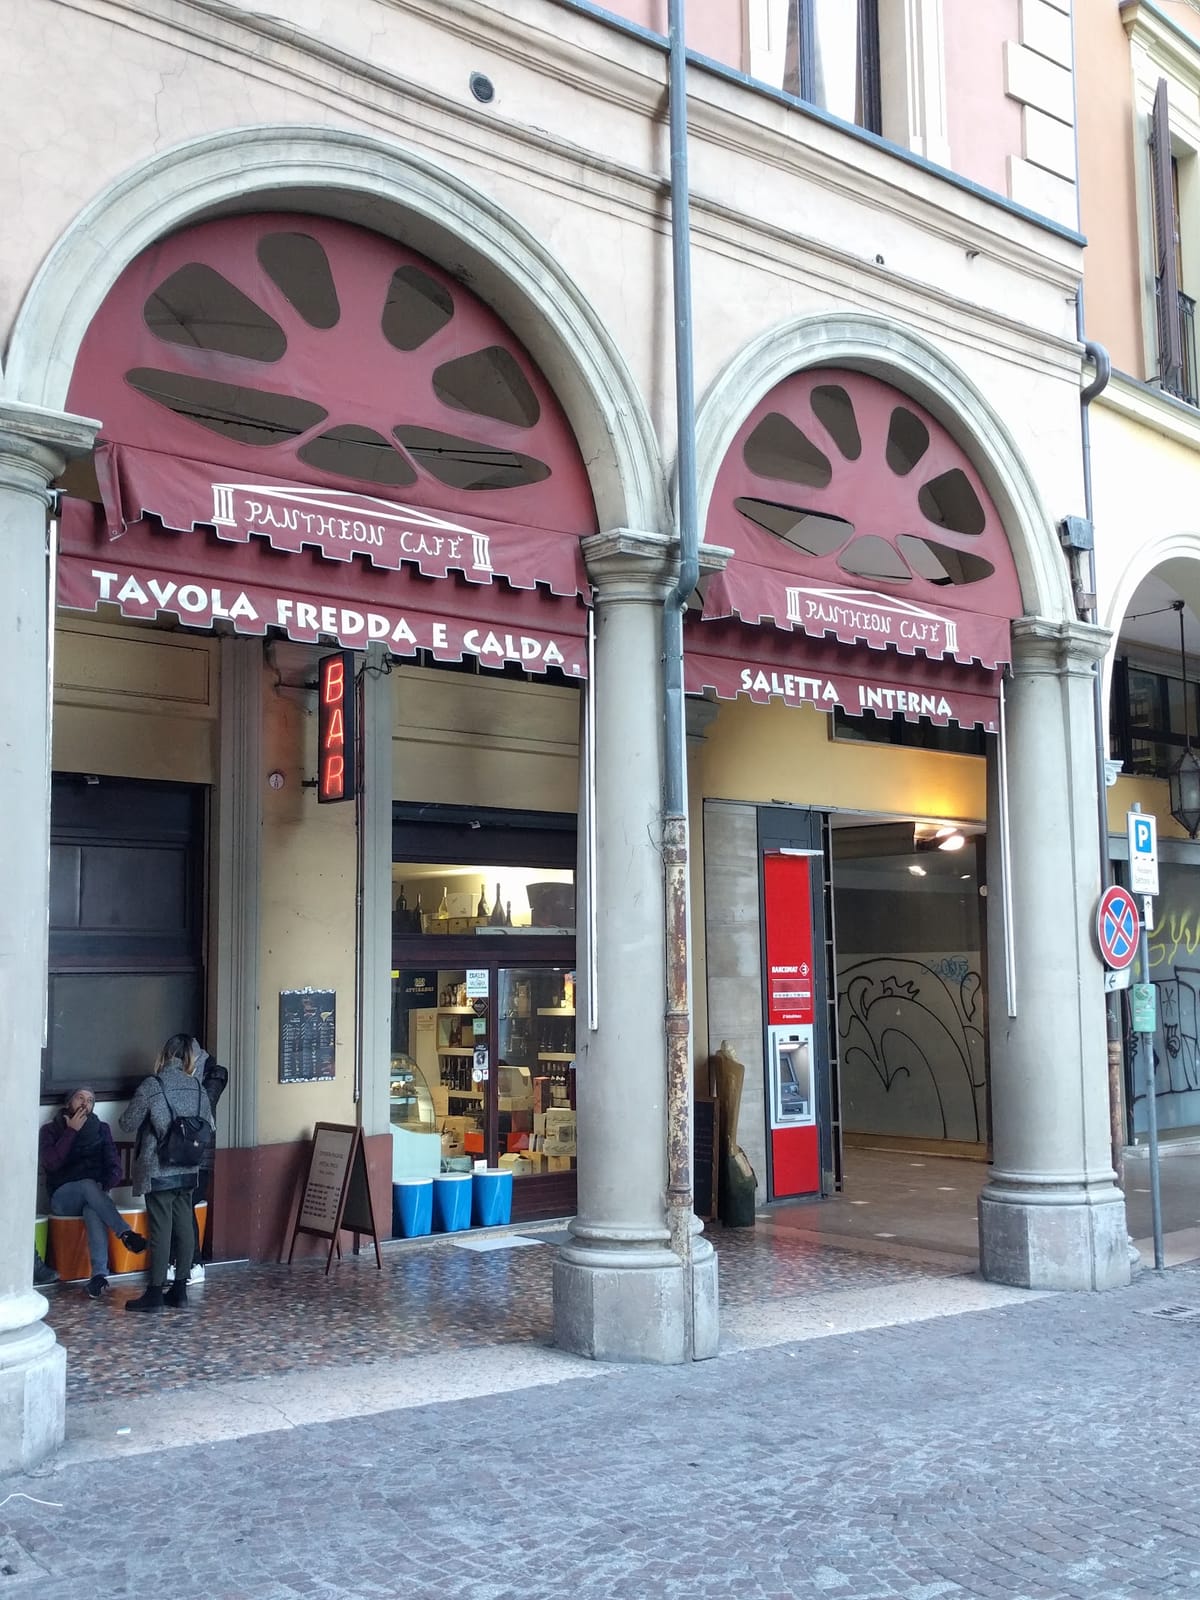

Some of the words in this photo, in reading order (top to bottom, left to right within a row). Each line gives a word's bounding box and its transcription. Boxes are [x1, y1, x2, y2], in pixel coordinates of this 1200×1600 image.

[244, 500, 386, 547] PANTHEON
[91, 569, 259, 621] TAVOLA
[276, 598, 417, 645] FREDDA
[432, 622, 448, 648] E
[805, 600, 892, 634] PANTHEON
[740, 668, 839, 703] SALETTA
[858, 685, 952, 717] INTERNA
[326, 662, 344, 794] BAR
[1138, 824, 1149, 848] P
